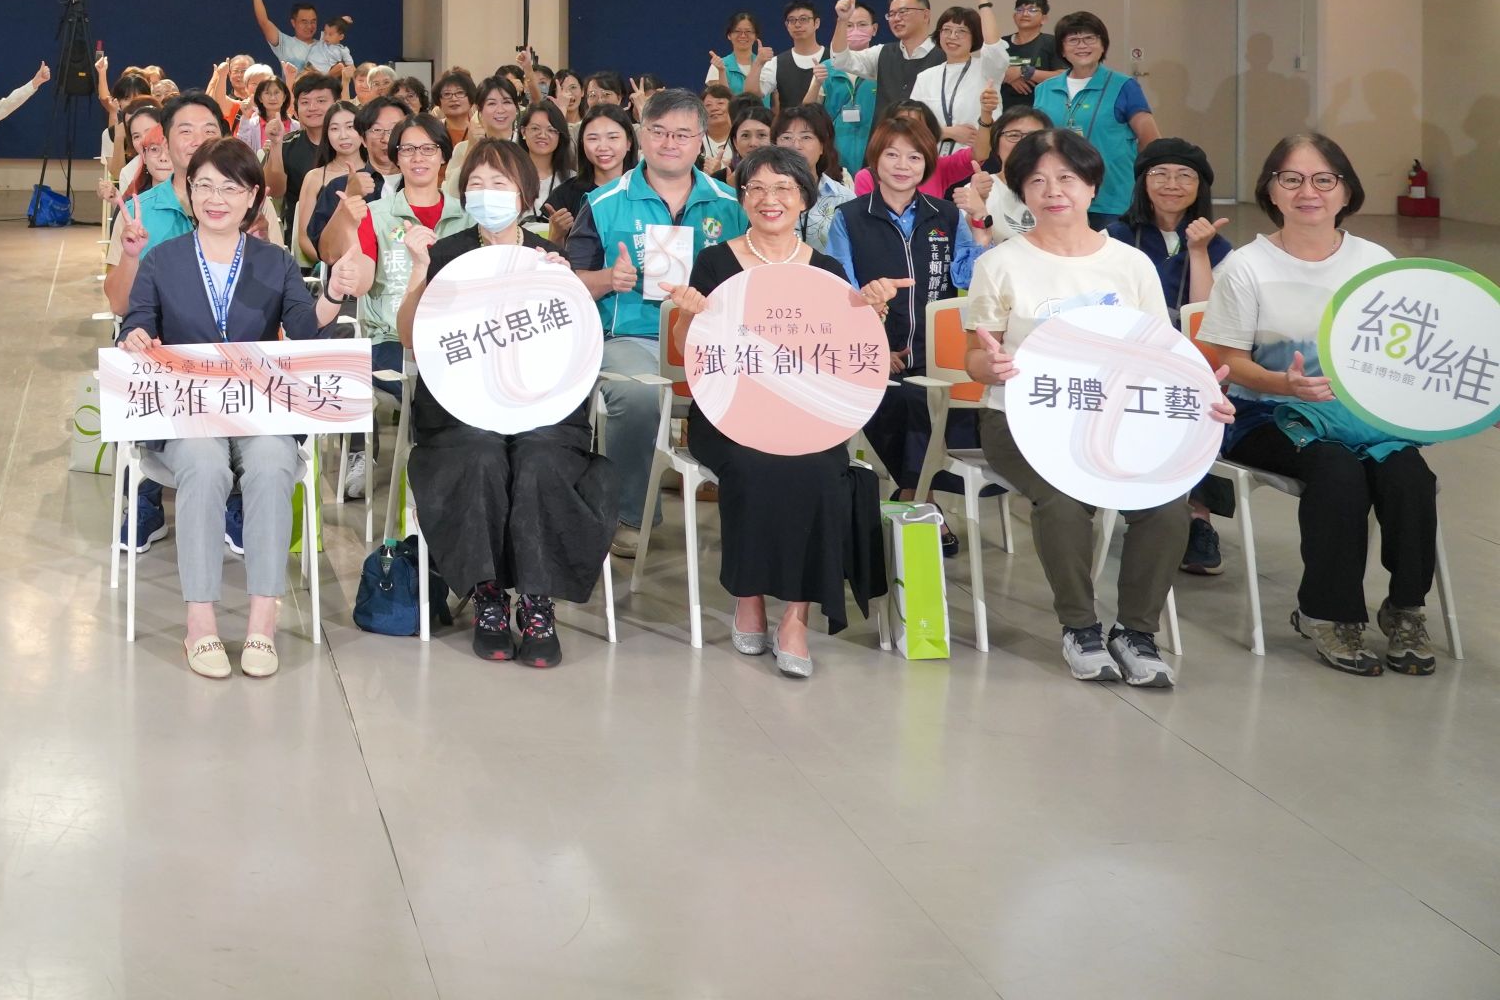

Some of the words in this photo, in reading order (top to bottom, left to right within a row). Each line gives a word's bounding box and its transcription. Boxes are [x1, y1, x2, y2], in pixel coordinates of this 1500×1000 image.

[438, 297, 574, 366] 當代思維
[765, 307, 803, 320] 2025
[131, 360, 174, 376] 2025
[693, 341, 881, 377] 纖維創作獎
[124, 373, 344, 420] 纖維創作獎
[1028, 373, 1109, 410] 身體
[1124, 384, 1201, 422] 工藝
